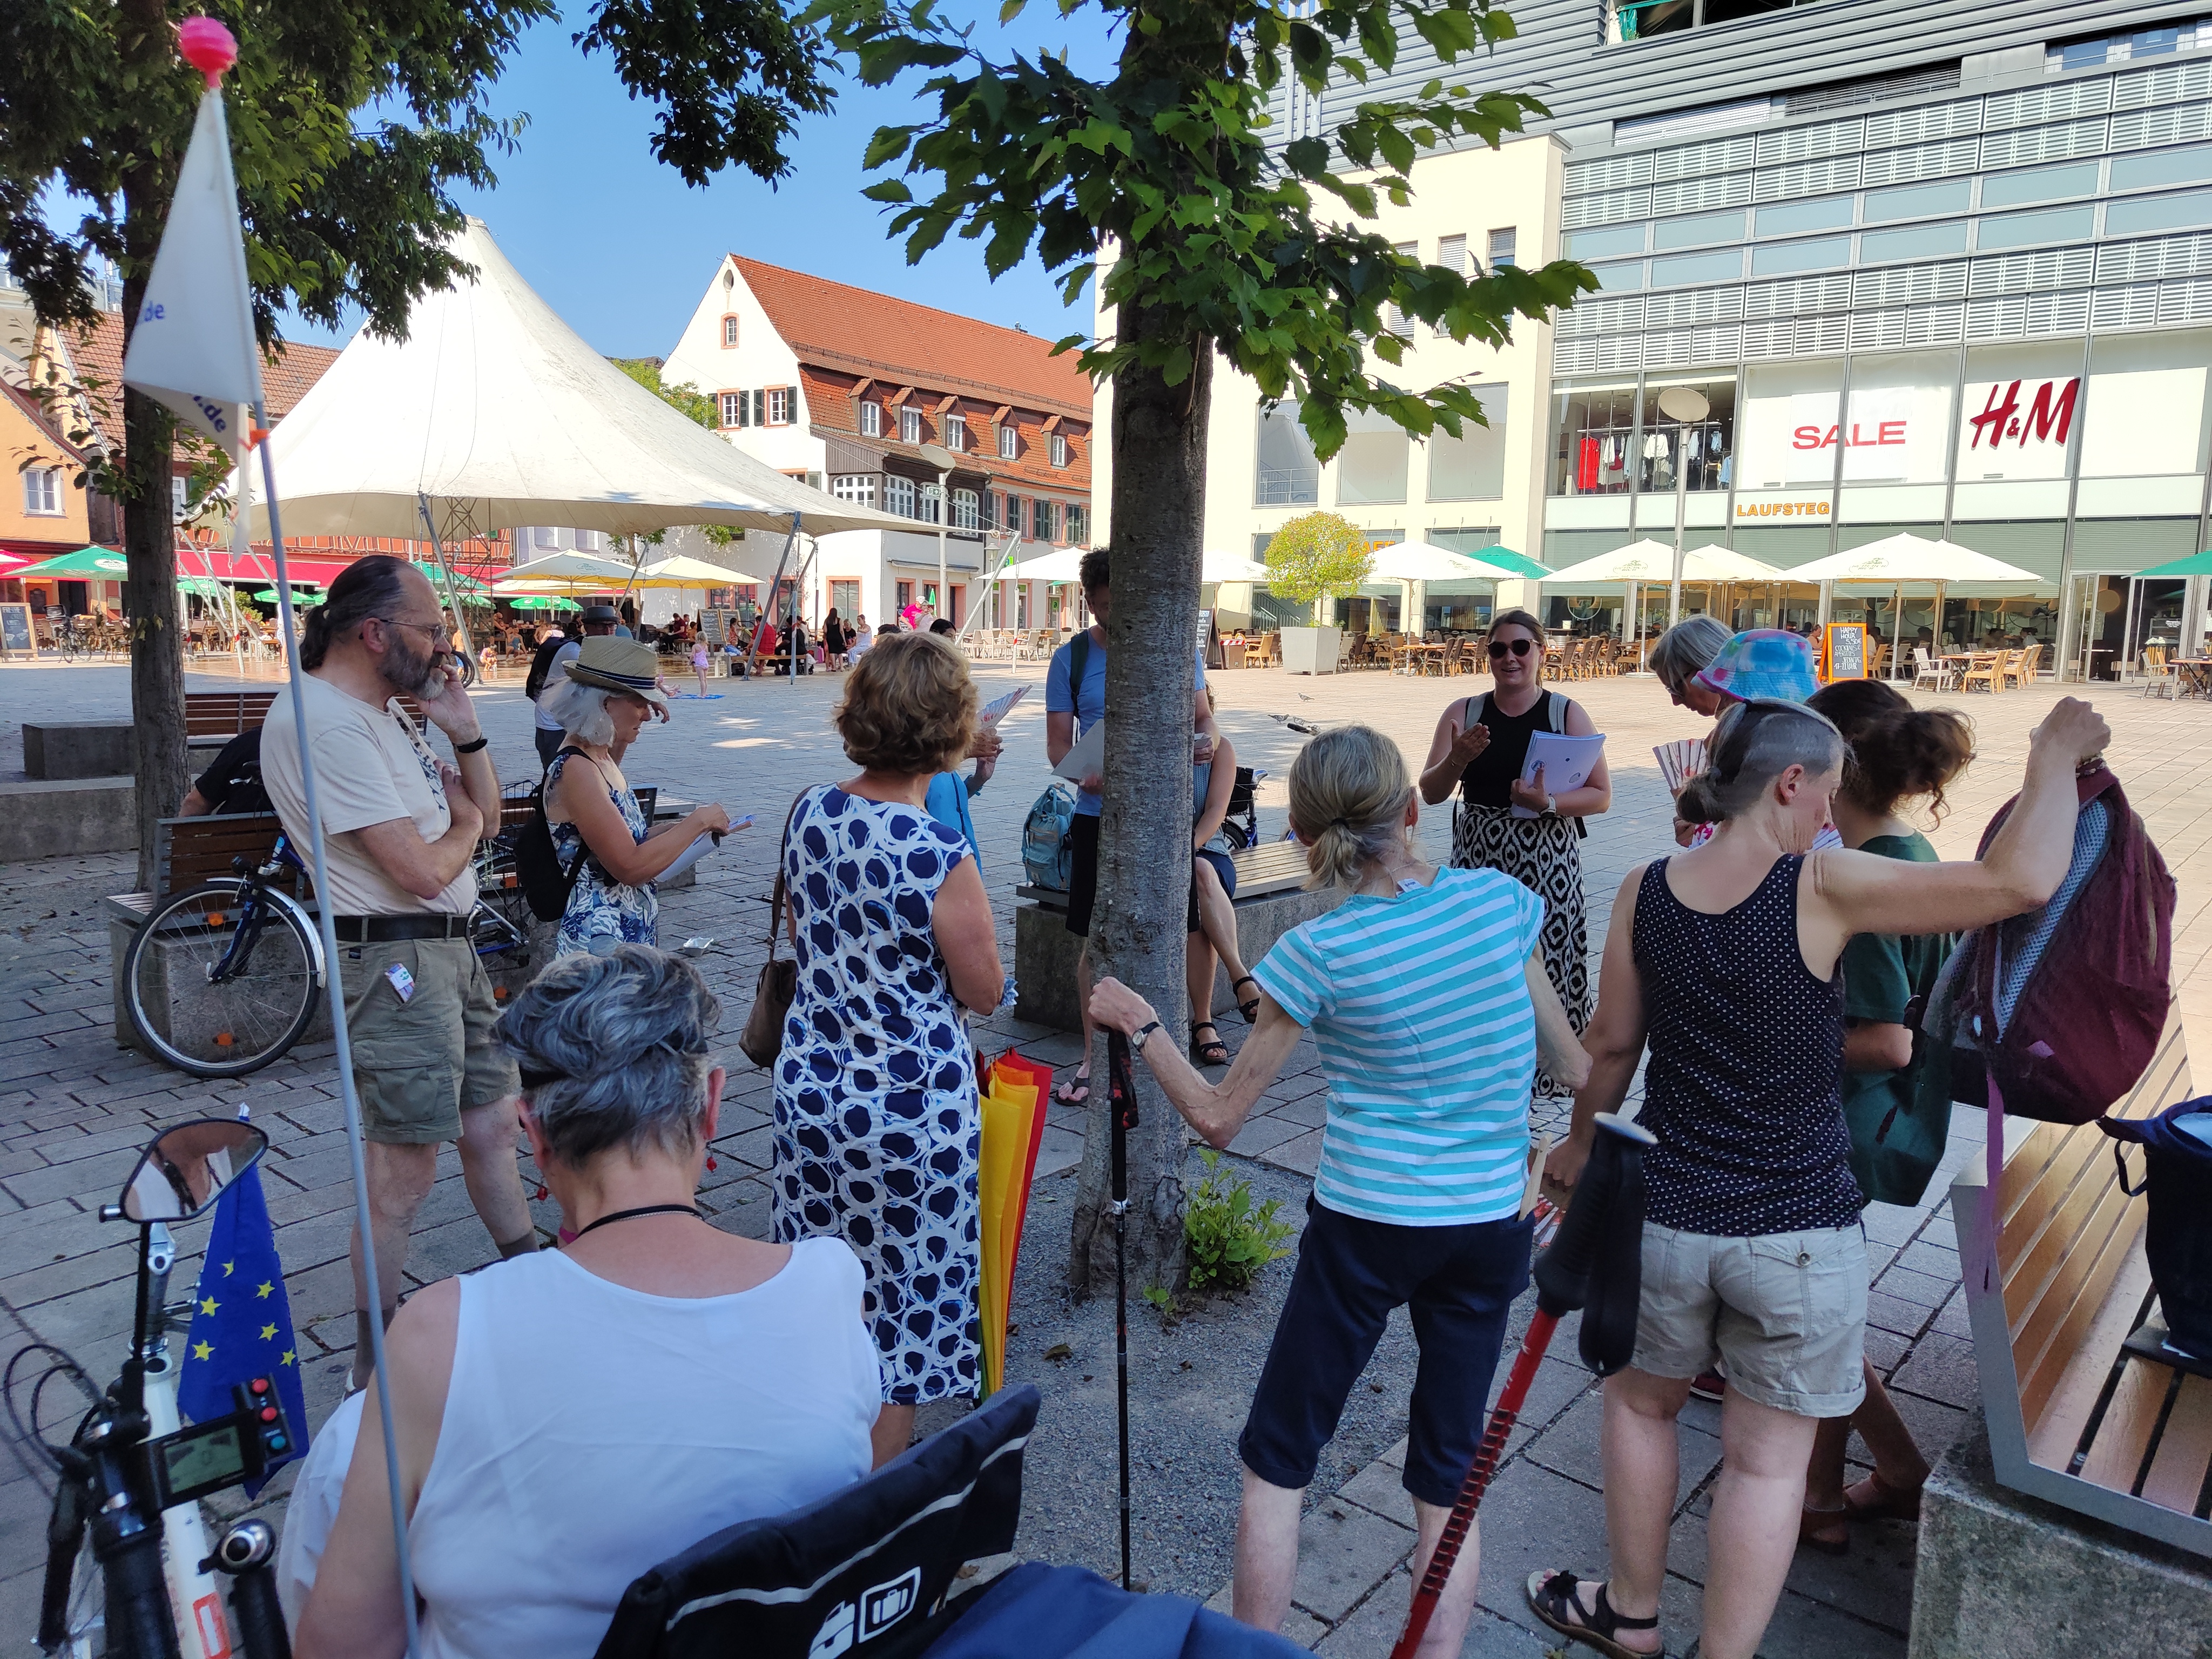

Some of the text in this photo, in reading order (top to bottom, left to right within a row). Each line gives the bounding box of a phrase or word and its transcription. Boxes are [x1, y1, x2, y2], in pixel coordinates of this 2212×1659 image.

[1970, 377, 2081, 449] H&M
[1792, 420, 1907, 449] SALE
[1737, 502, 1830, 516] LAUFSTEG
